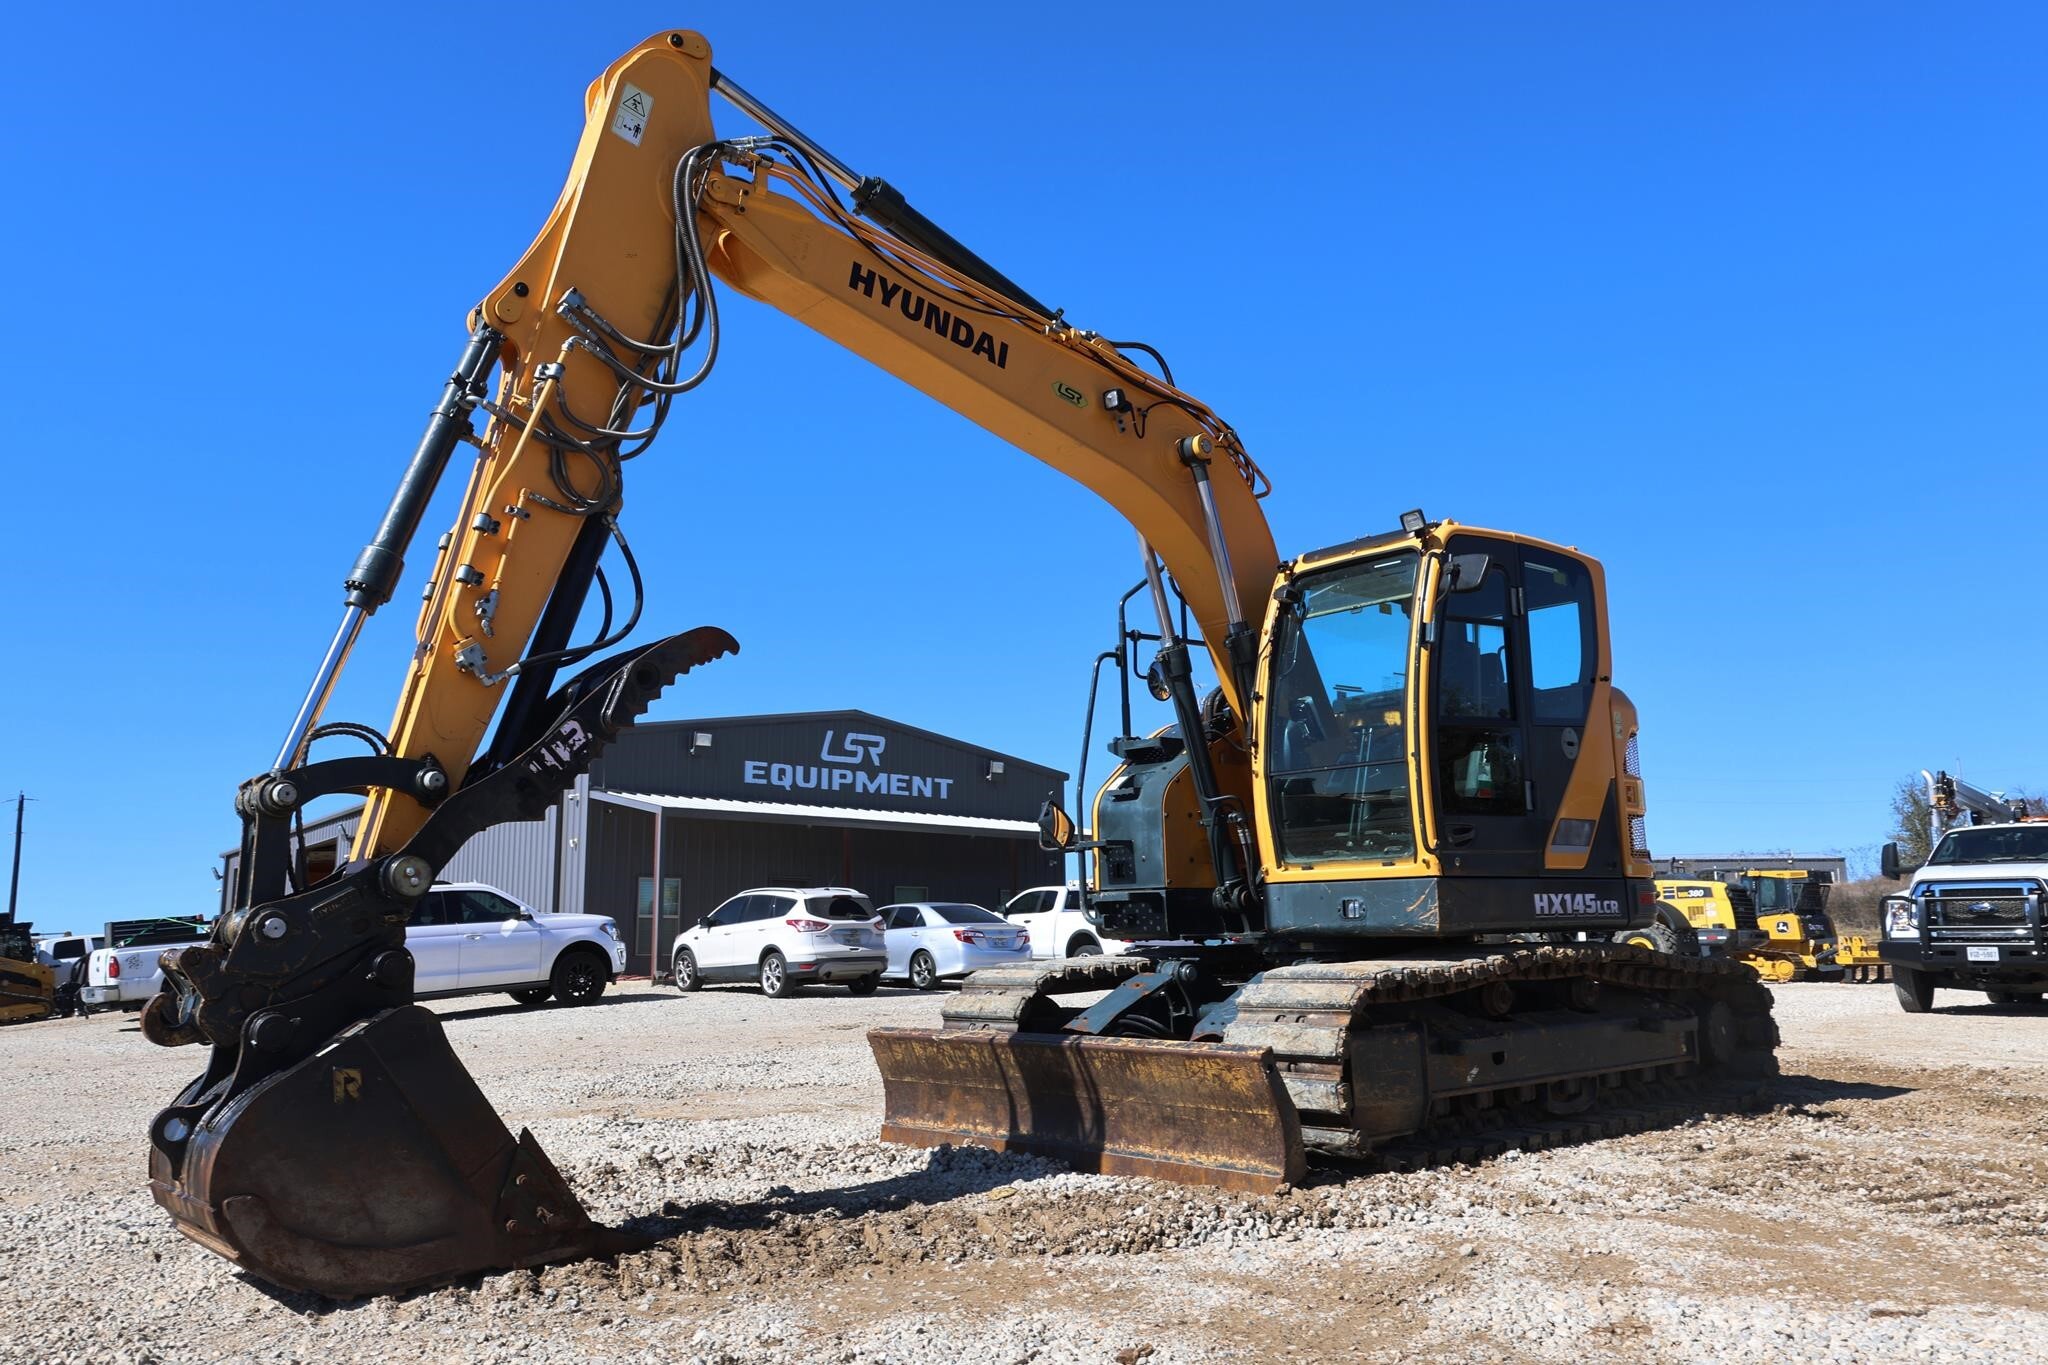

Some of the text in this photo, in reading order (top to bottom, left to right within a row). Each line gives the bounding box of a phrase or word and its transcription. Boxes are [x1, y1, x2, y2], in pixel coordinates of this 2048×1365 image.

[849, 261, 1009, 369] HYUNDAI
[1058, 383, 1082, 405] LSR
[820, 730, 886, 766] LSR
[744, 760, 954, 799] EQUIPMENT
[1534, 893, 1621, 915] HX145LCR
